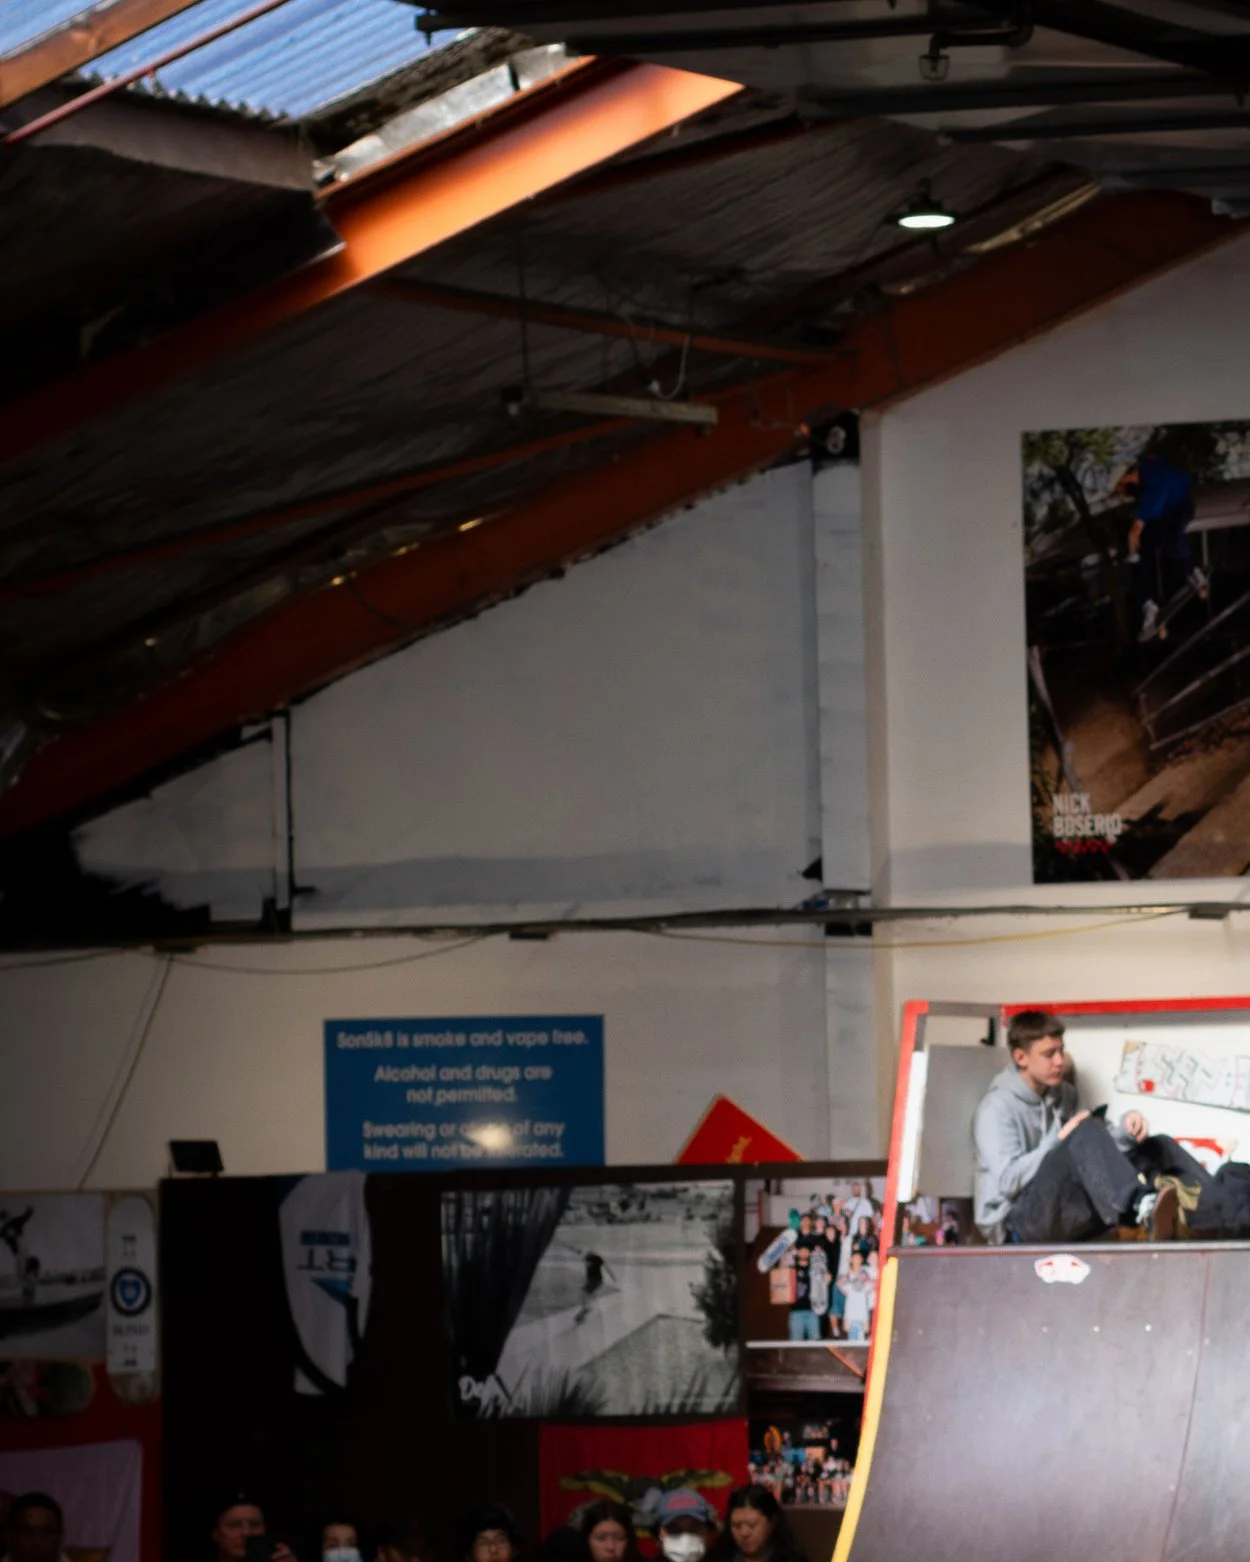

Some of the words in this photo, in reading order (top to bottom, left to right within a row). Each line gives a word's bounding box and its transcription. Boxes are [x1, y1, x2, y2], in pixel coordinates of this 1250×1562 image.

[1052, 793, 1092, 815] NICK
[413, 1030, 466, 1048] smoke
[469, 1029, 502, 1047] and
[506, 1031, 549, 1049] vape
[374, 1064, 437, 1082] Alcohol
[440, 1064, 473, 1080] and
[476, 1065, 520, 1084] drugs
[524, 1066, 553, 1080] are
[406, 1087, 433, 1103] not
[363, 1121, 436, 1141] Swearing
[440, 1123, 456, 1137] or
[513, 1120, 531, 1137] of
[533, 1121, 566, 1138] any
[363, 1142, 399, 1159] kind
[403, 1142, 428, 1159] will
[431, 1142, 459, 1159] not
